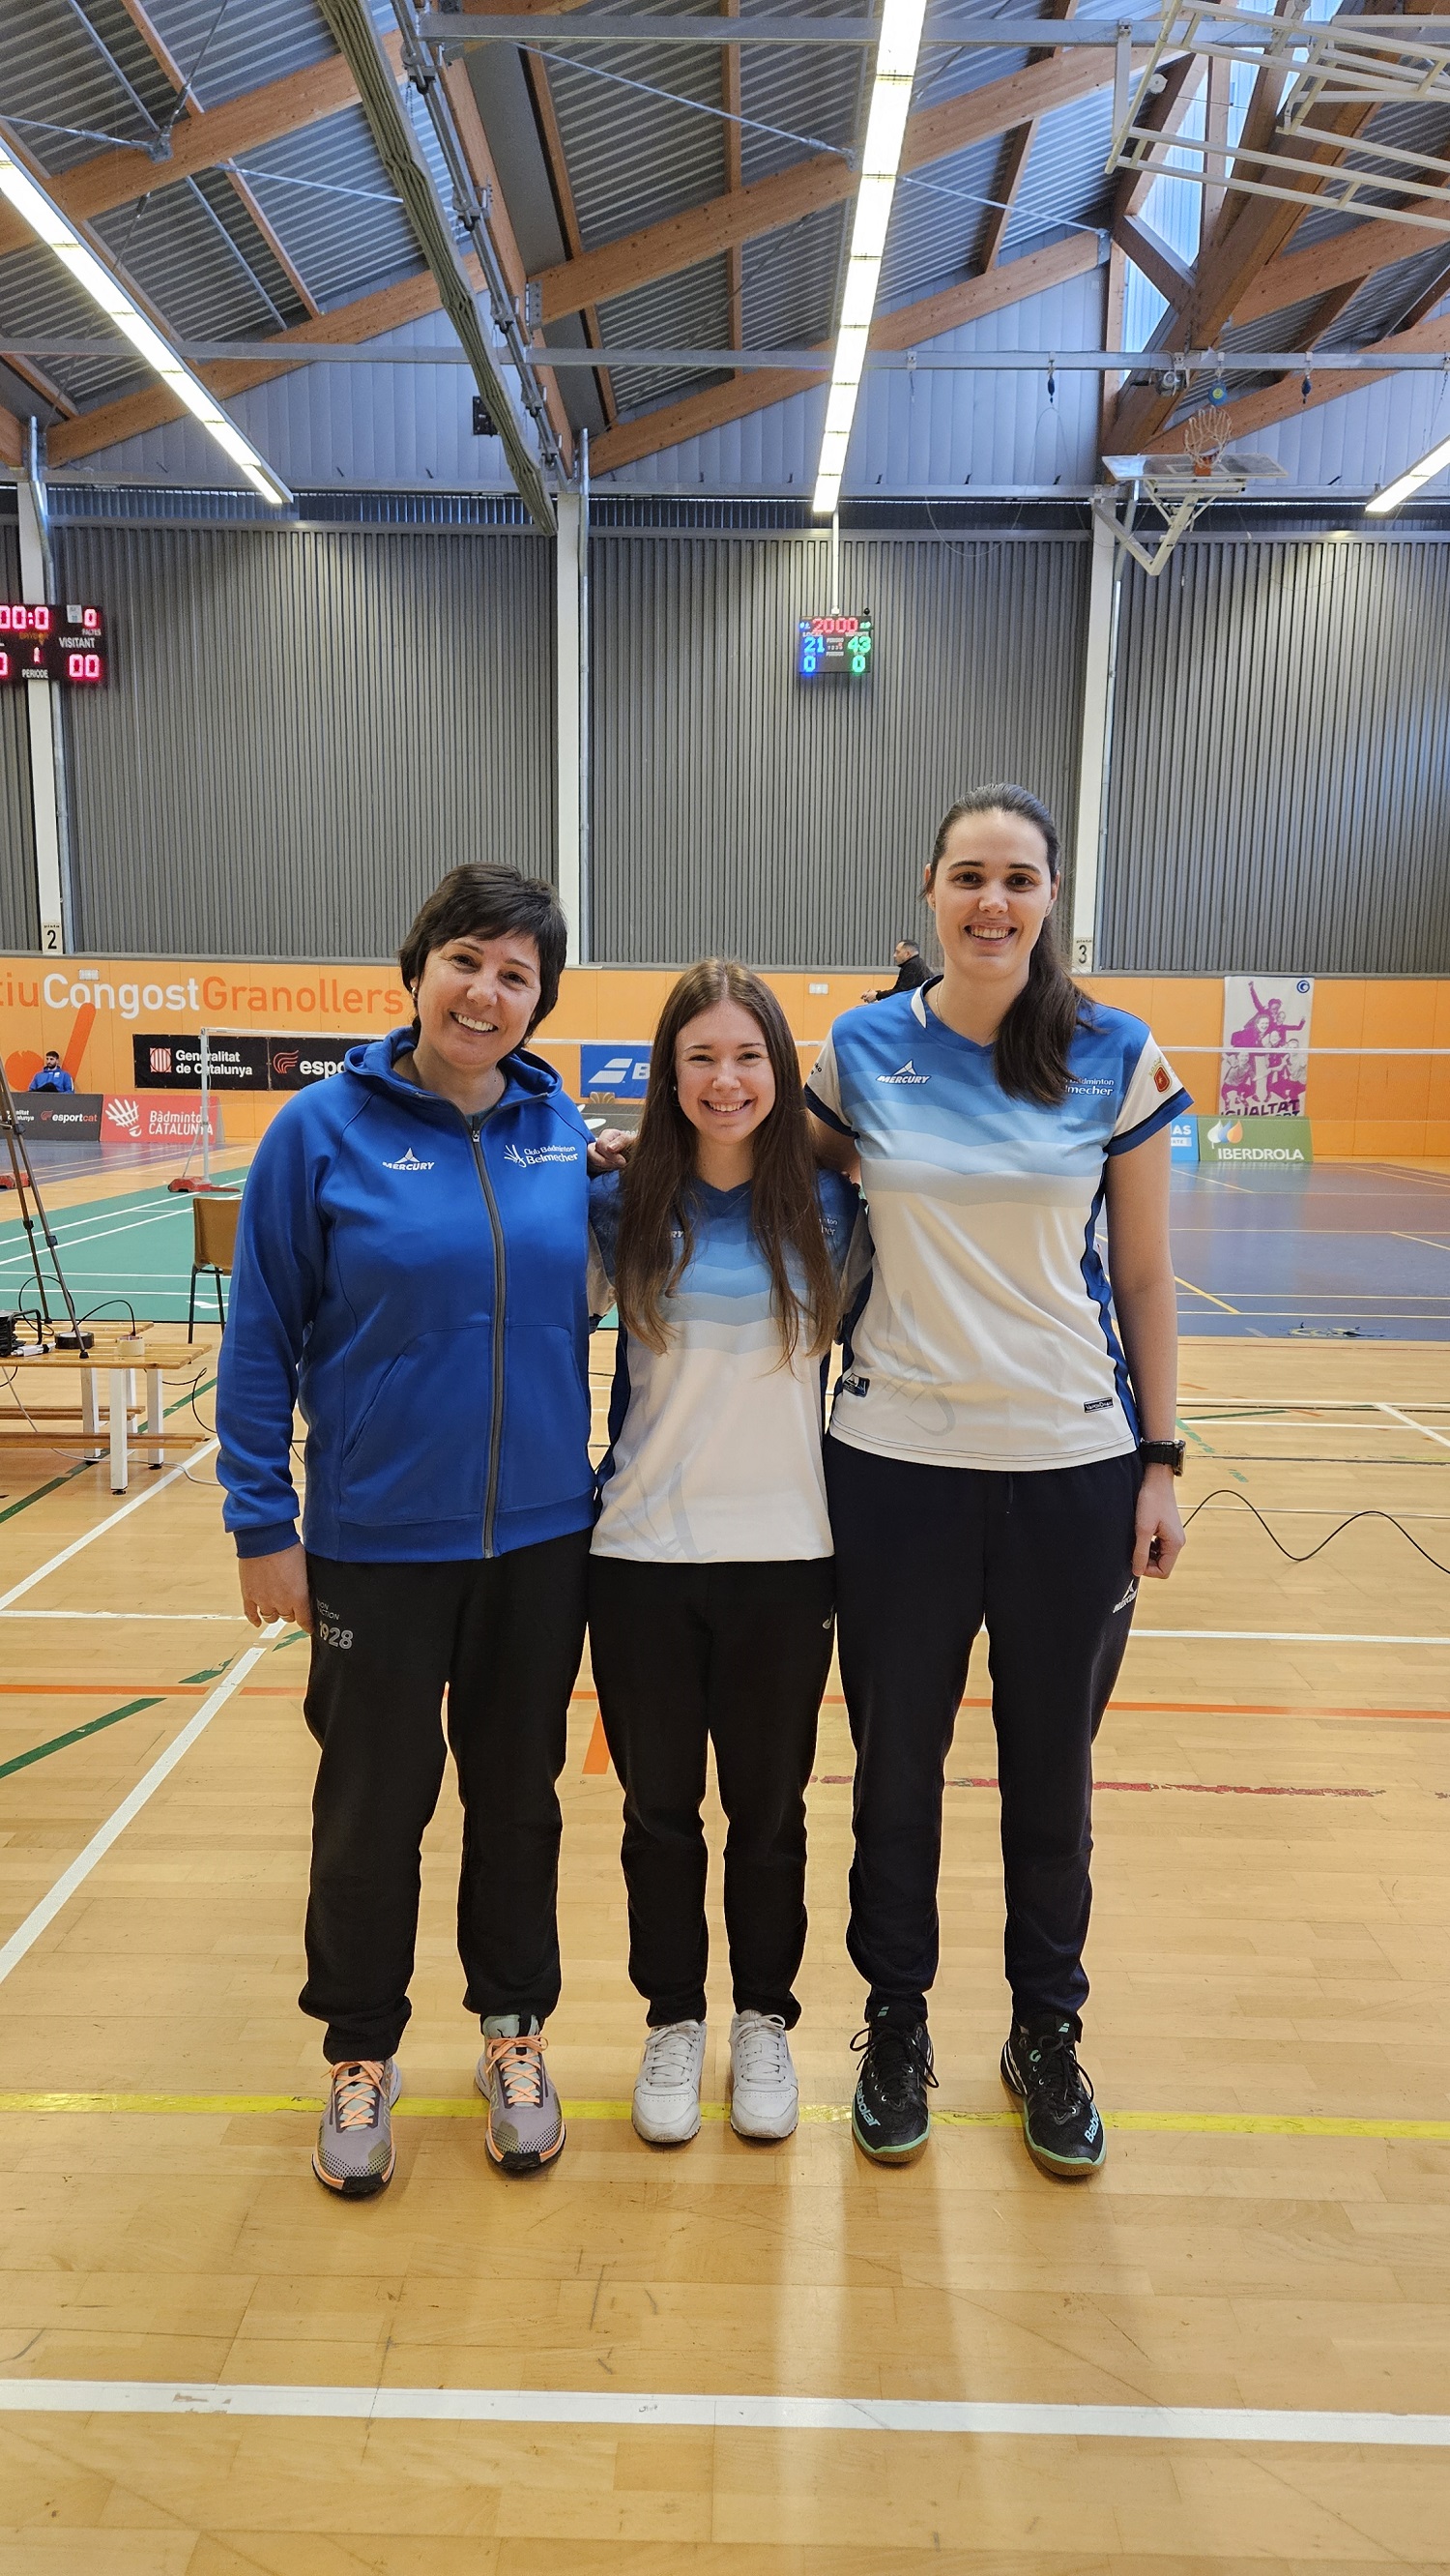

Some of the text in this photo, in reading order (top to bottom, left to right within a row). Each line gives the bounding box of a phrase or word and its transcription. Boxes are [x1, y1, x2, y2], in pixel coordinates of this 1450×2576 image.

[84, 608, 97, 628] 0
[59, 637, 95, 648] VISITANT
[804, 636, 825, 653] 21
[848, 636, 871, 654] 43
[70, 654, 100, 677] 00
[803, 656, 816, 672] 0
[852, 656, 865, 672] 0
[22, 669, 48, 678] PERIODE
[47, 930, 57, 949] 2
[1079, 945, 1088, 964] 3
[176, 1049, 241, 1063] Genralitat
[176, 1063, 253, 1077] de Ctalunya
[877, 1075, 930, 1084] MERCURY
[52, 1113, 98, 1123] esportcat
[150, 1111, 209, 1123] Bàdminto
[526, 1154, 578, 1164] Belmecher
[1218, 1148, 1304, 1160] IBERDROLA
[382, 1161, 435, 1171] MERCURY
